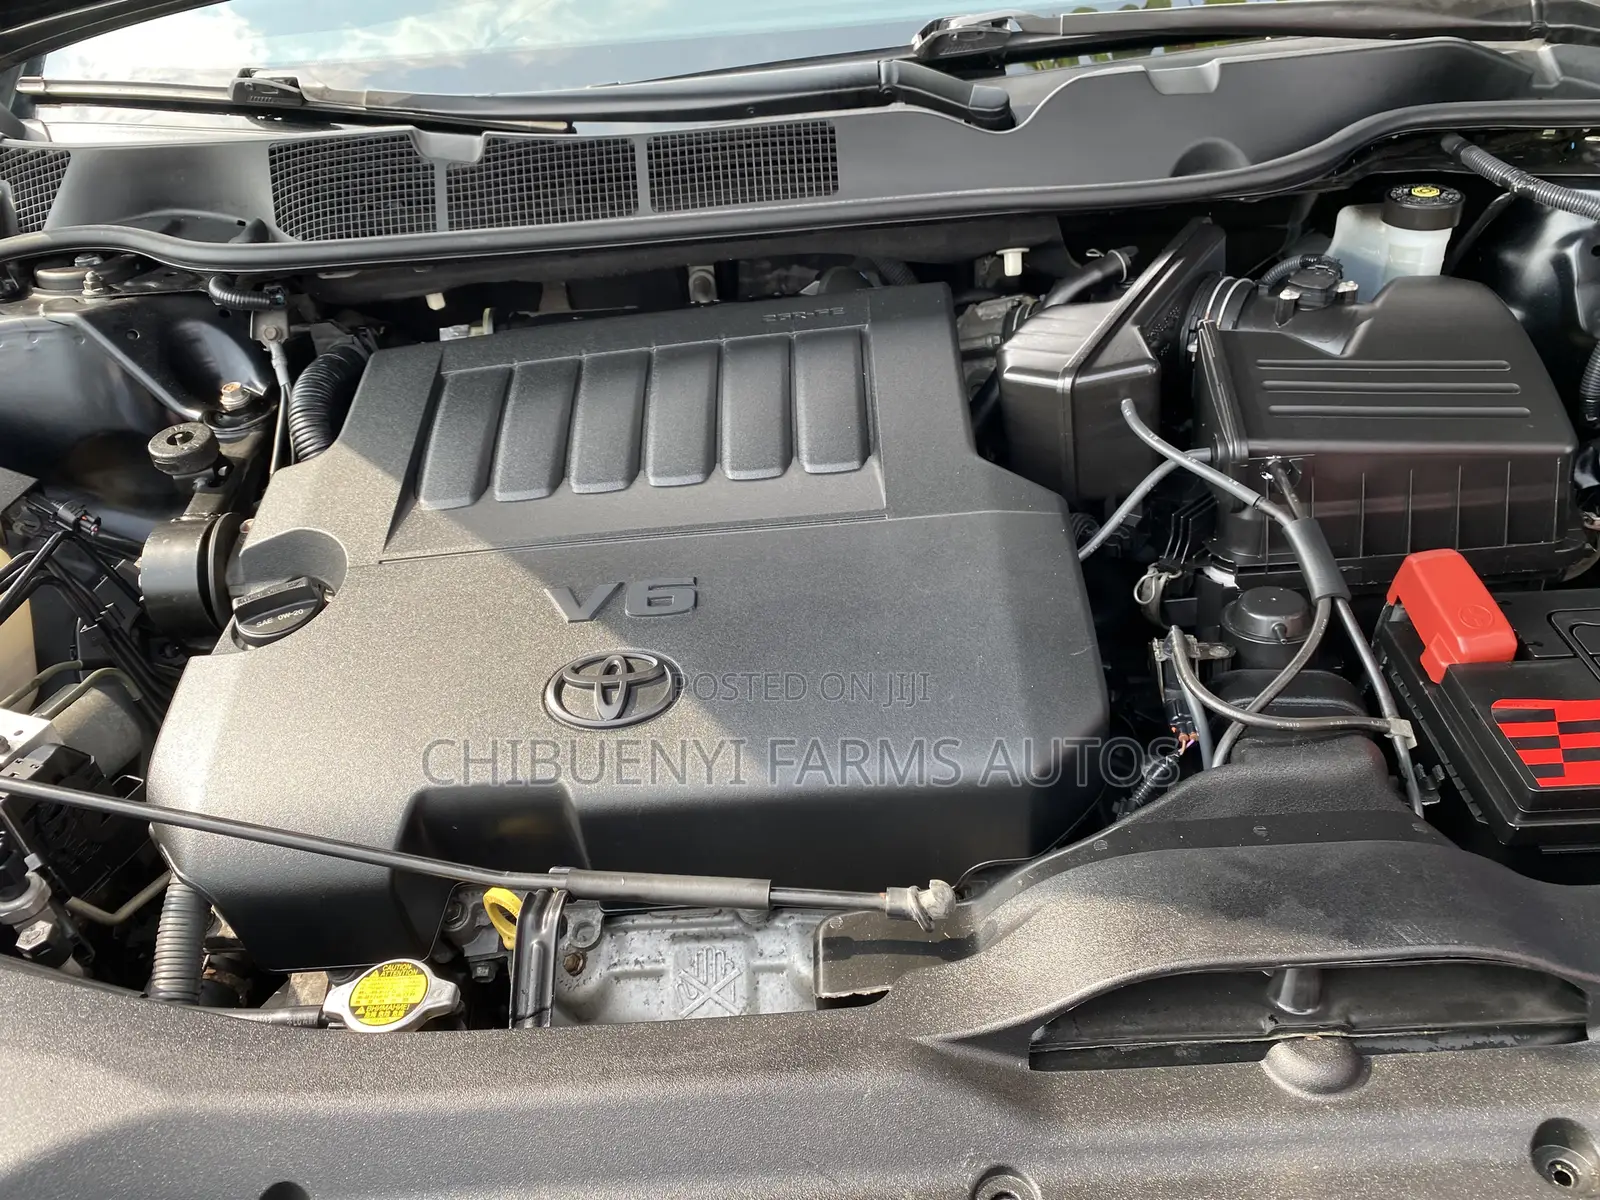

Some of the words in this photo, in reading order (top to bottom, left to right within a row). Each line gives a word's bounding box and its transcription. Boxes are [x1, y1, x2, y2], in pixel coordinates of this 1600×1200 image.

[543, 576, 698, 623] V6
[256, 617, 273, 628] SAE
[382, 963, 412, 971] CAUTION
[380, 969, 418, 977] ATTENTION
